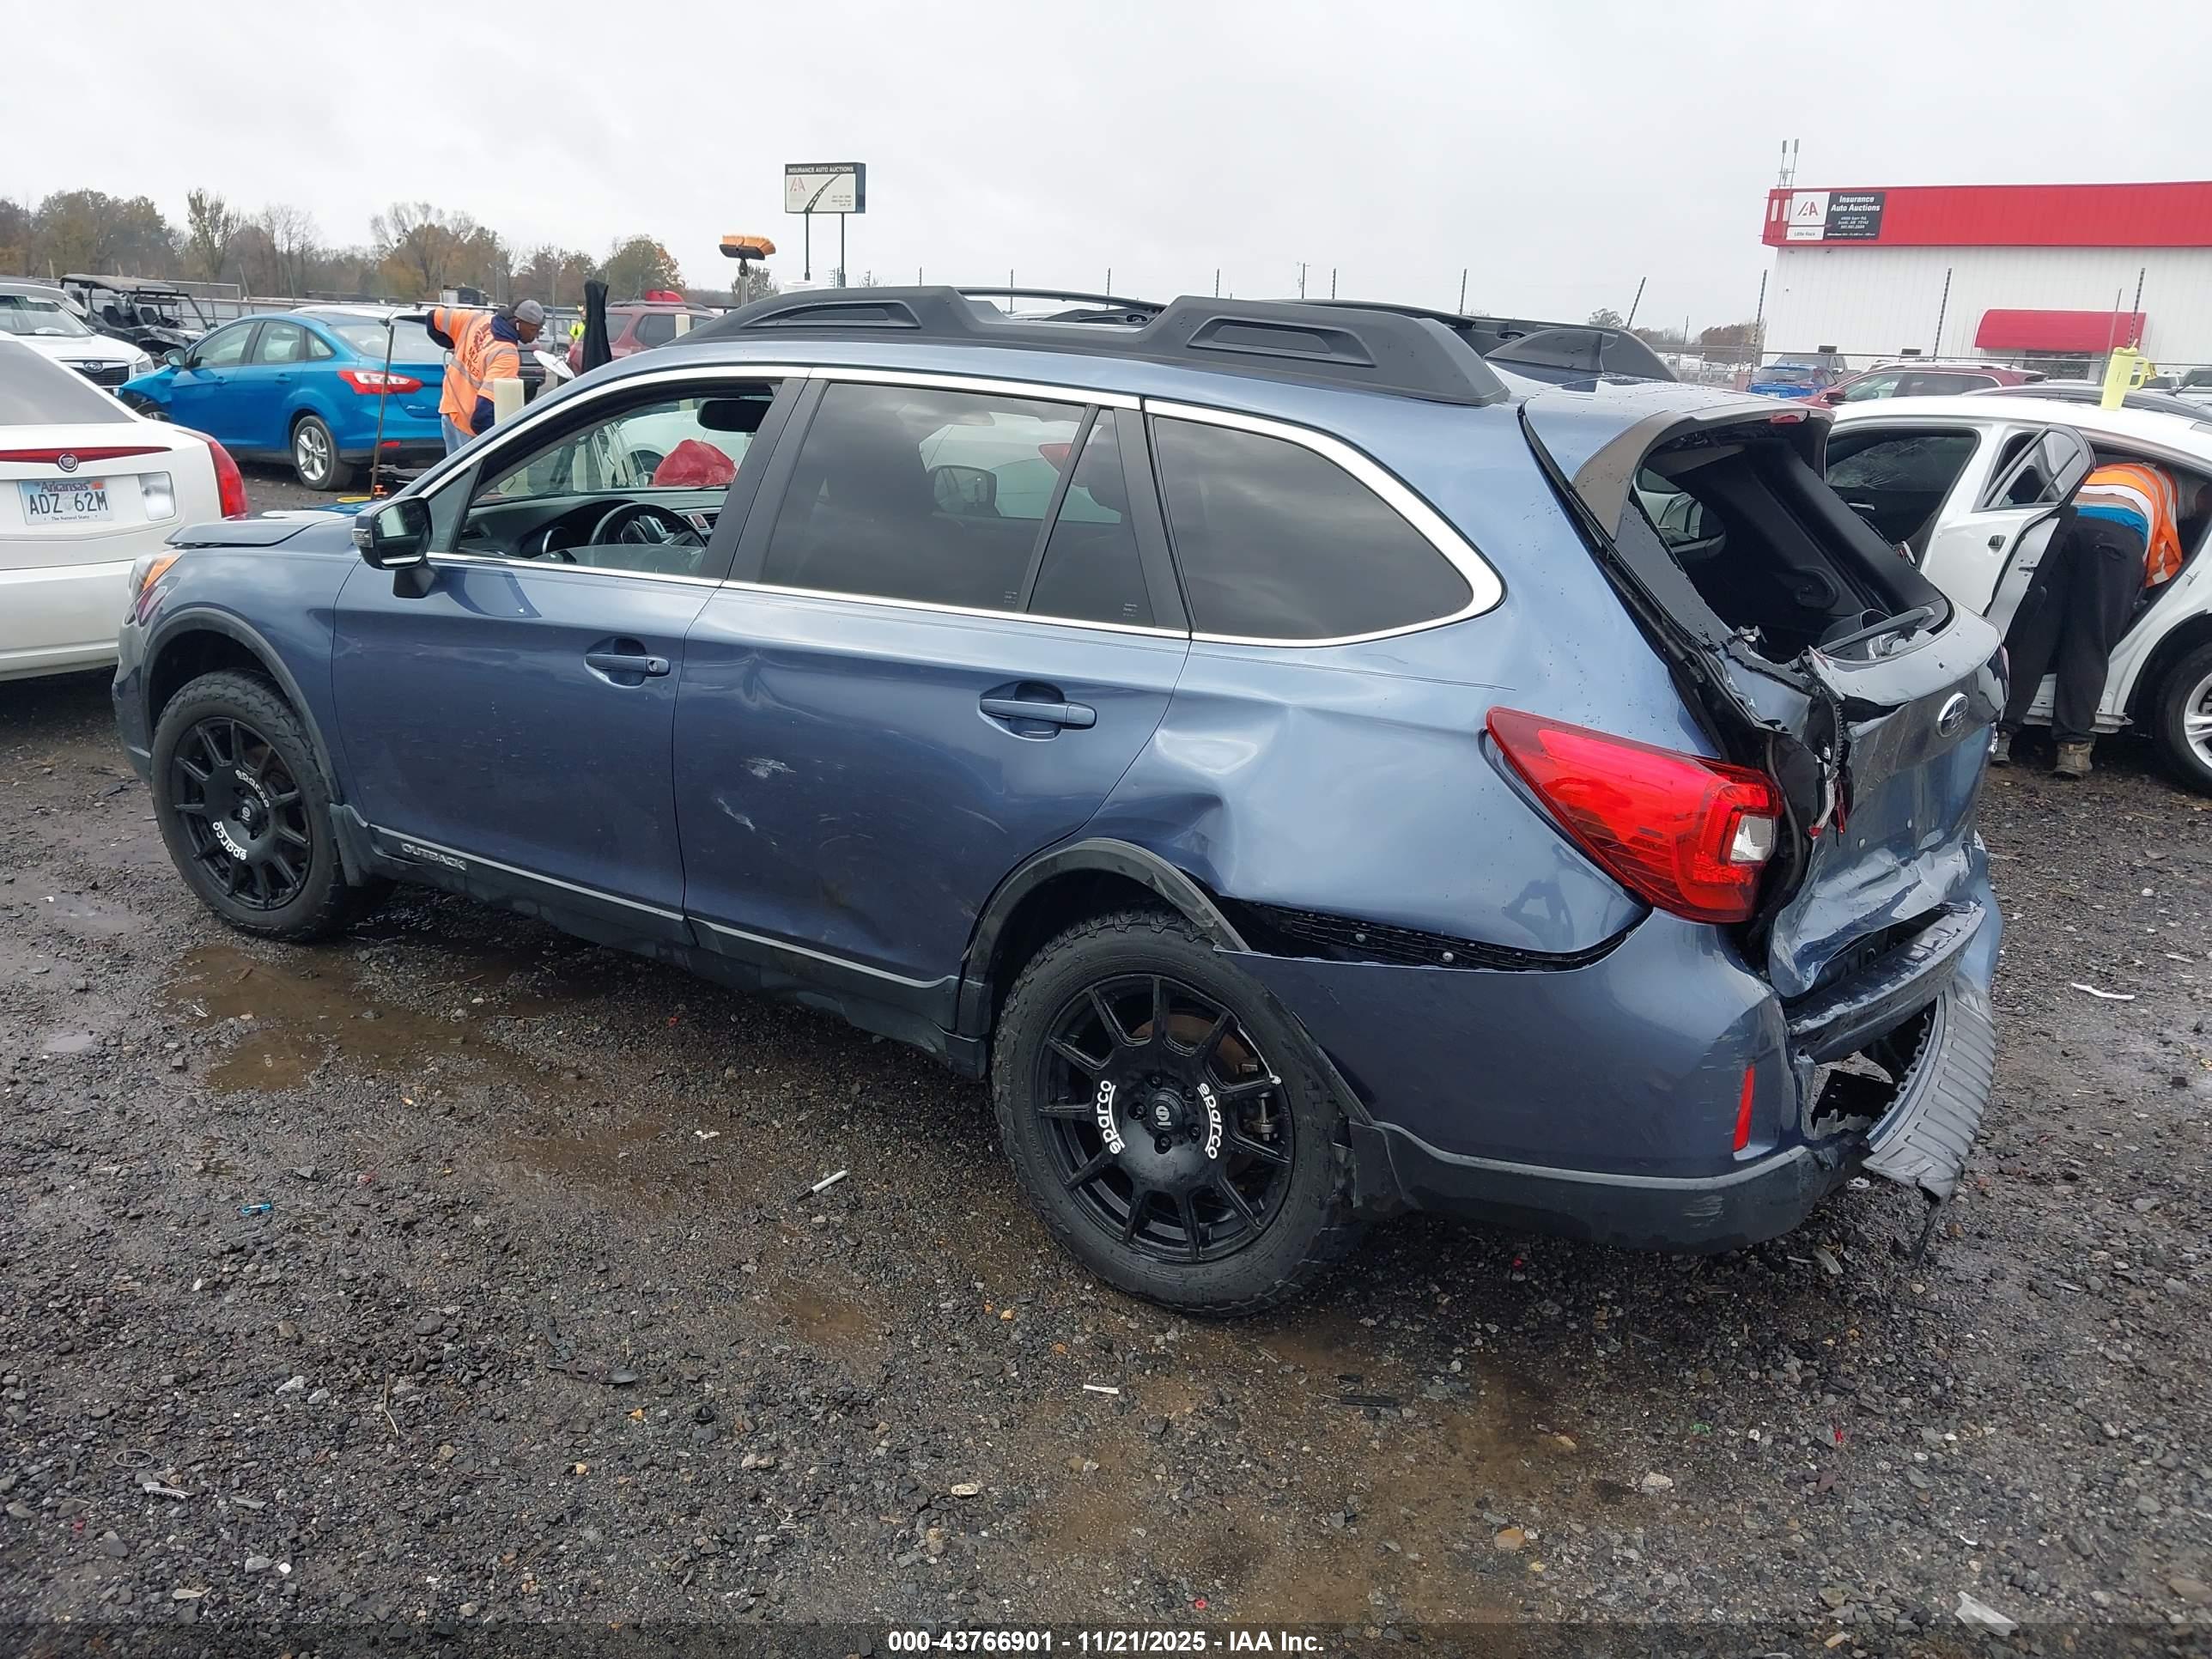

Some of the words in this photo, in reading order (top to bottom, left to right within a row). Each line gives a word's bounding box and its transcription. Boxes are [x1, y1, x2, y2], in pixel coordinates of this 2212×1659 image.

[29, 493, 63, 514] ADZ
[74, 490, 108, 512] 62M
[41, 482, 88, 493] Arkansas
[235, 769, 270, 808] sparco
[212, 820, 247, 861] sparco
[402, 842, 467, 871] OUTBACK
[1096, 1079, 1126, 1155] sparco
[1197, 1082, 1224, 1160] sparco
